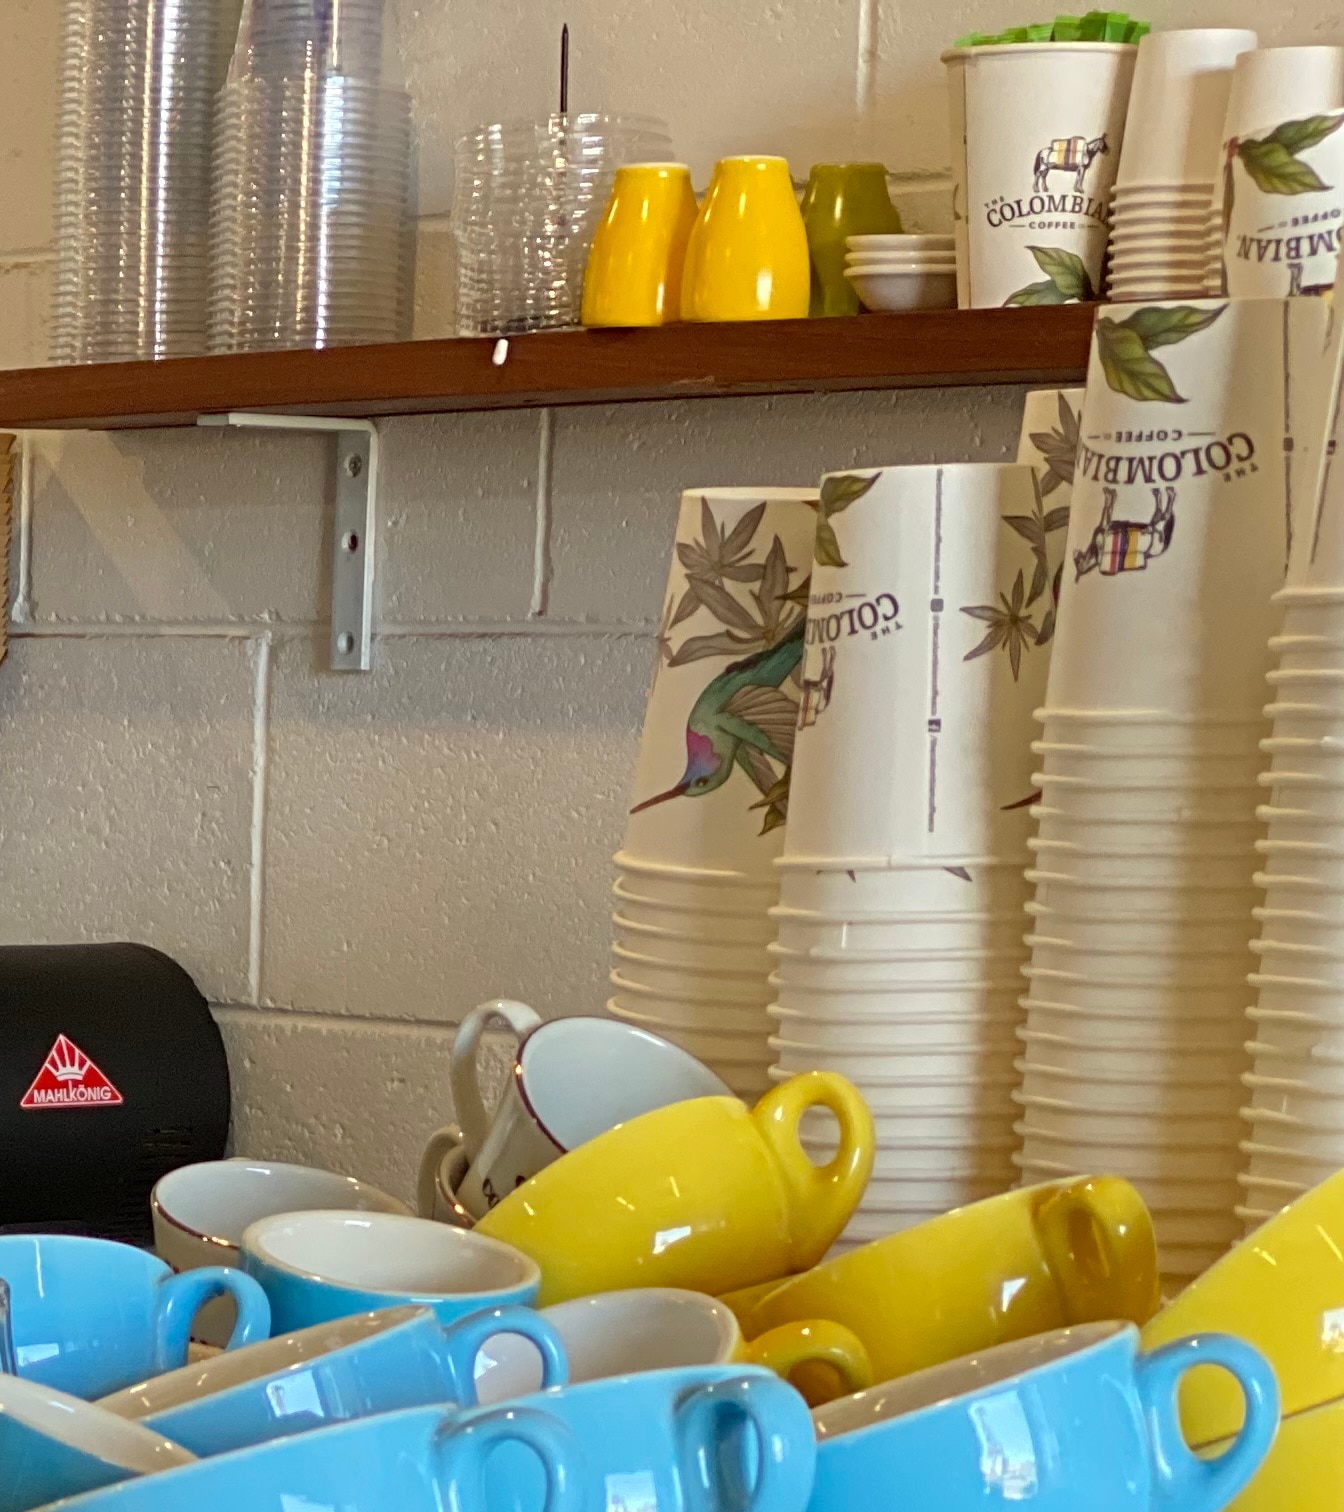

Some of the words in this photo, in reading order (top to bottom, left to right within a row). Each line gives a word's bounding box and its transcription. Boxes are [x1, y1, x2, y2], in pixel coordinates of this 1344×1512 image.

[1028, 221, 1076, 230] COFFEE
[1115, 430, 1182, 443] COFFEE
[33, 1083, 112, 1104] MAHLKÖNIG
